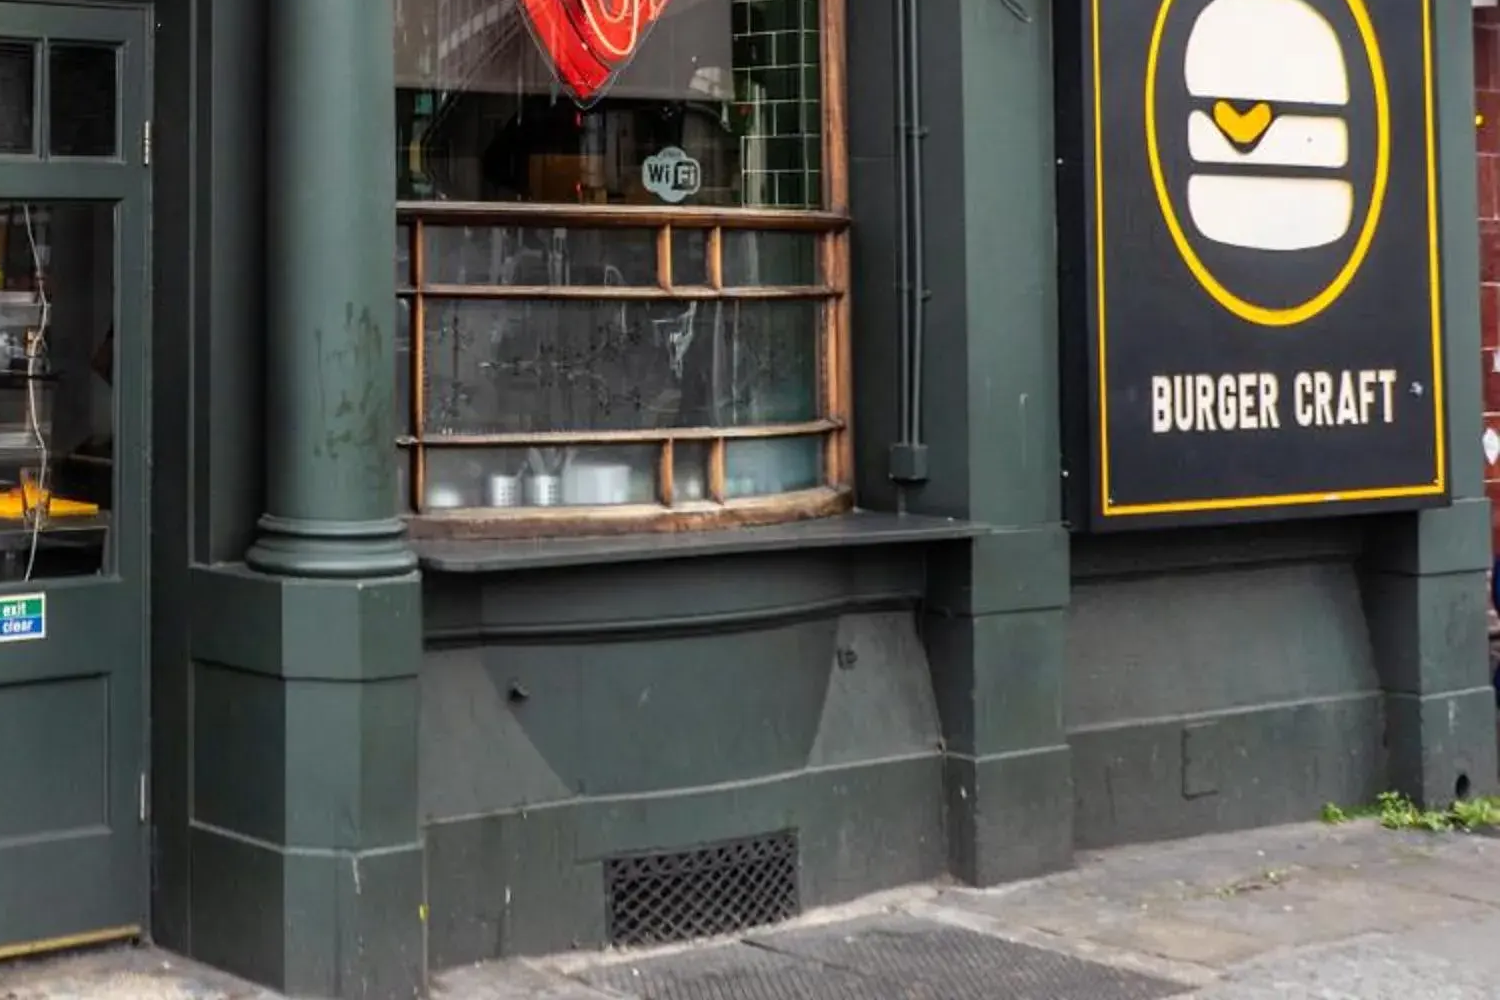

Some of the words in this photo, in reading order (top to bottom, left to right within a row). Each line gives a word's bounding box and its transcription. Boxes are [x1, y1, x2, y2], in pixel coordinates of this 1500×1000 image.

[1152, 373, 1280, 433] BURGER
[1294, 368, 1397, 427] CRAFT
[3, 601, 27, 616] exit
[3, 618, 34, 635] clear
